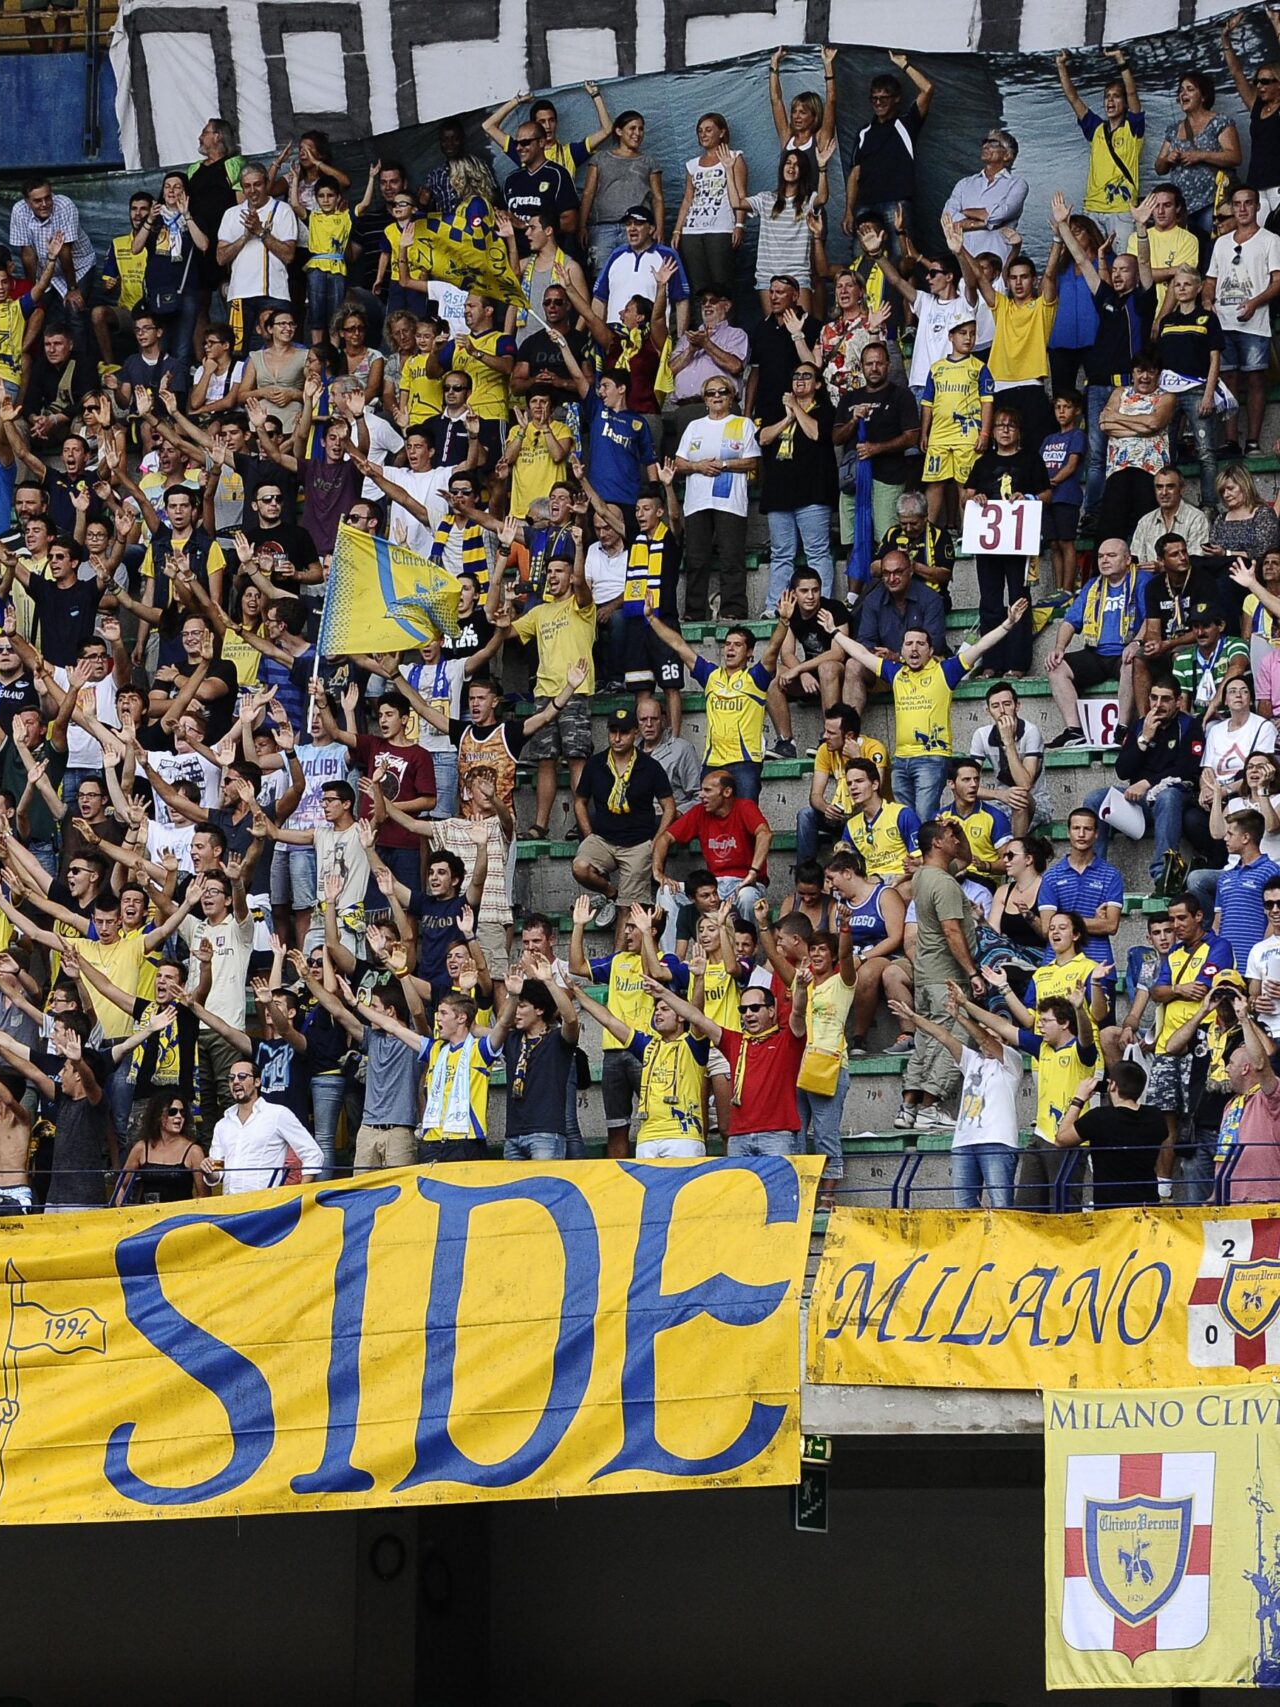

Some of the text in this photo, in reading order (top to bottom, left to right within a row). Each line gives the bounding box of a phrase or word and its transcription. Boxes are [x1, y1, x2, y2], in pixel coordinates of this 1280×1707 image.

[927, 455, 941, 473] 31
[978, 503, 1026, 551] 31
[1104, 596, 1125, 612] ANS
[661, 661, 680, 681] 26
[578, 1097, 589, 1109] 75
[866, 1089, 877, 1101] 79
[1220, 1238, 1235, 1258] 2
[823, 1248, 1172, 1348] MILANO
[43, 1315, 90, 1342] 1994
[103, 1155, 801, 1506] SIDE
[1205, 1325, 1218, 1345] 0
[1049, 1398, 1185, 1431] MILANO
[1126, 1593, 1144, 1603] 1929
